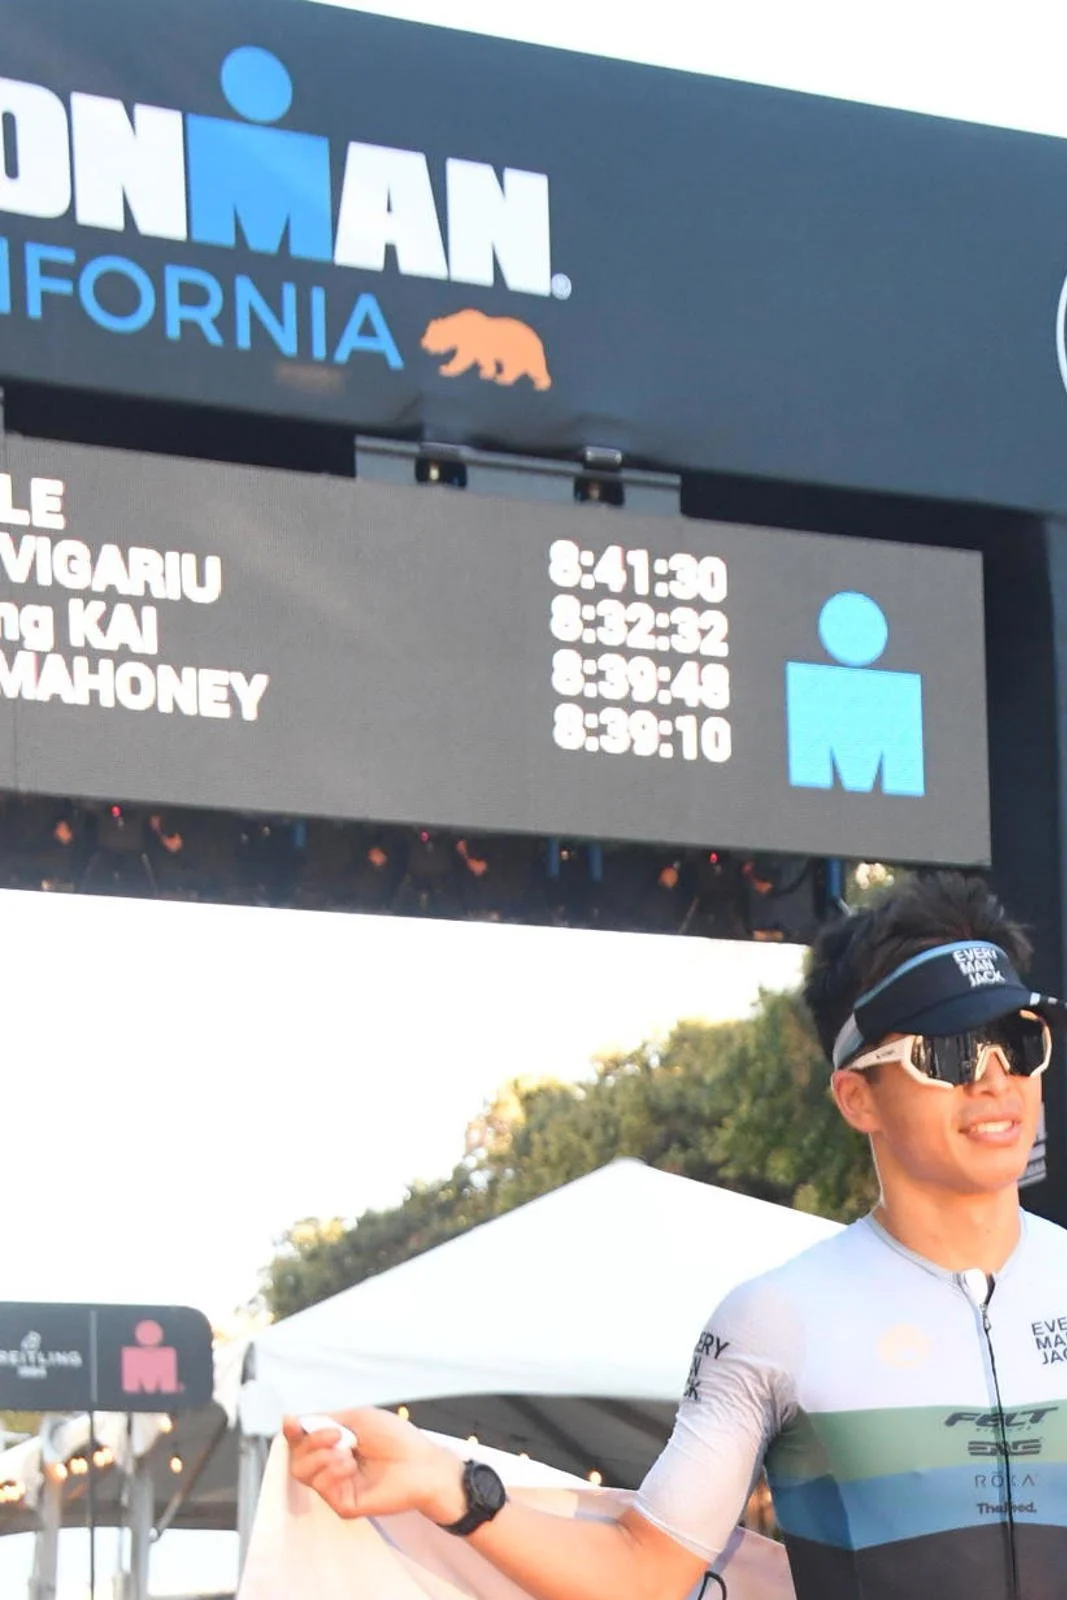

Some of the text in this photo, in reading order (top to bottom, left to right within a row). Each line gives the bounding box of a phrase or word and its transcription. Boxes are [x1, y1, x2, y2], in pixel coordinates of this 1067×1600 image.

[0, 532, 222, 604] VIGARIU
[549, 539, 728, 603] 8:41:30
[68, 598, 158, 654] KAI
[550, 594, 729, 657] 8:32:32
[0, 649, 269, 721] MAHONEY
[551, 649, 730, 710] 8:39:48
[553, 703, 732, 763] 8:39:10
[953, 948, 998, 962] EVERY
[959, 960, 995, 976] MAN
[969, 970, 1006, 988] JACK
